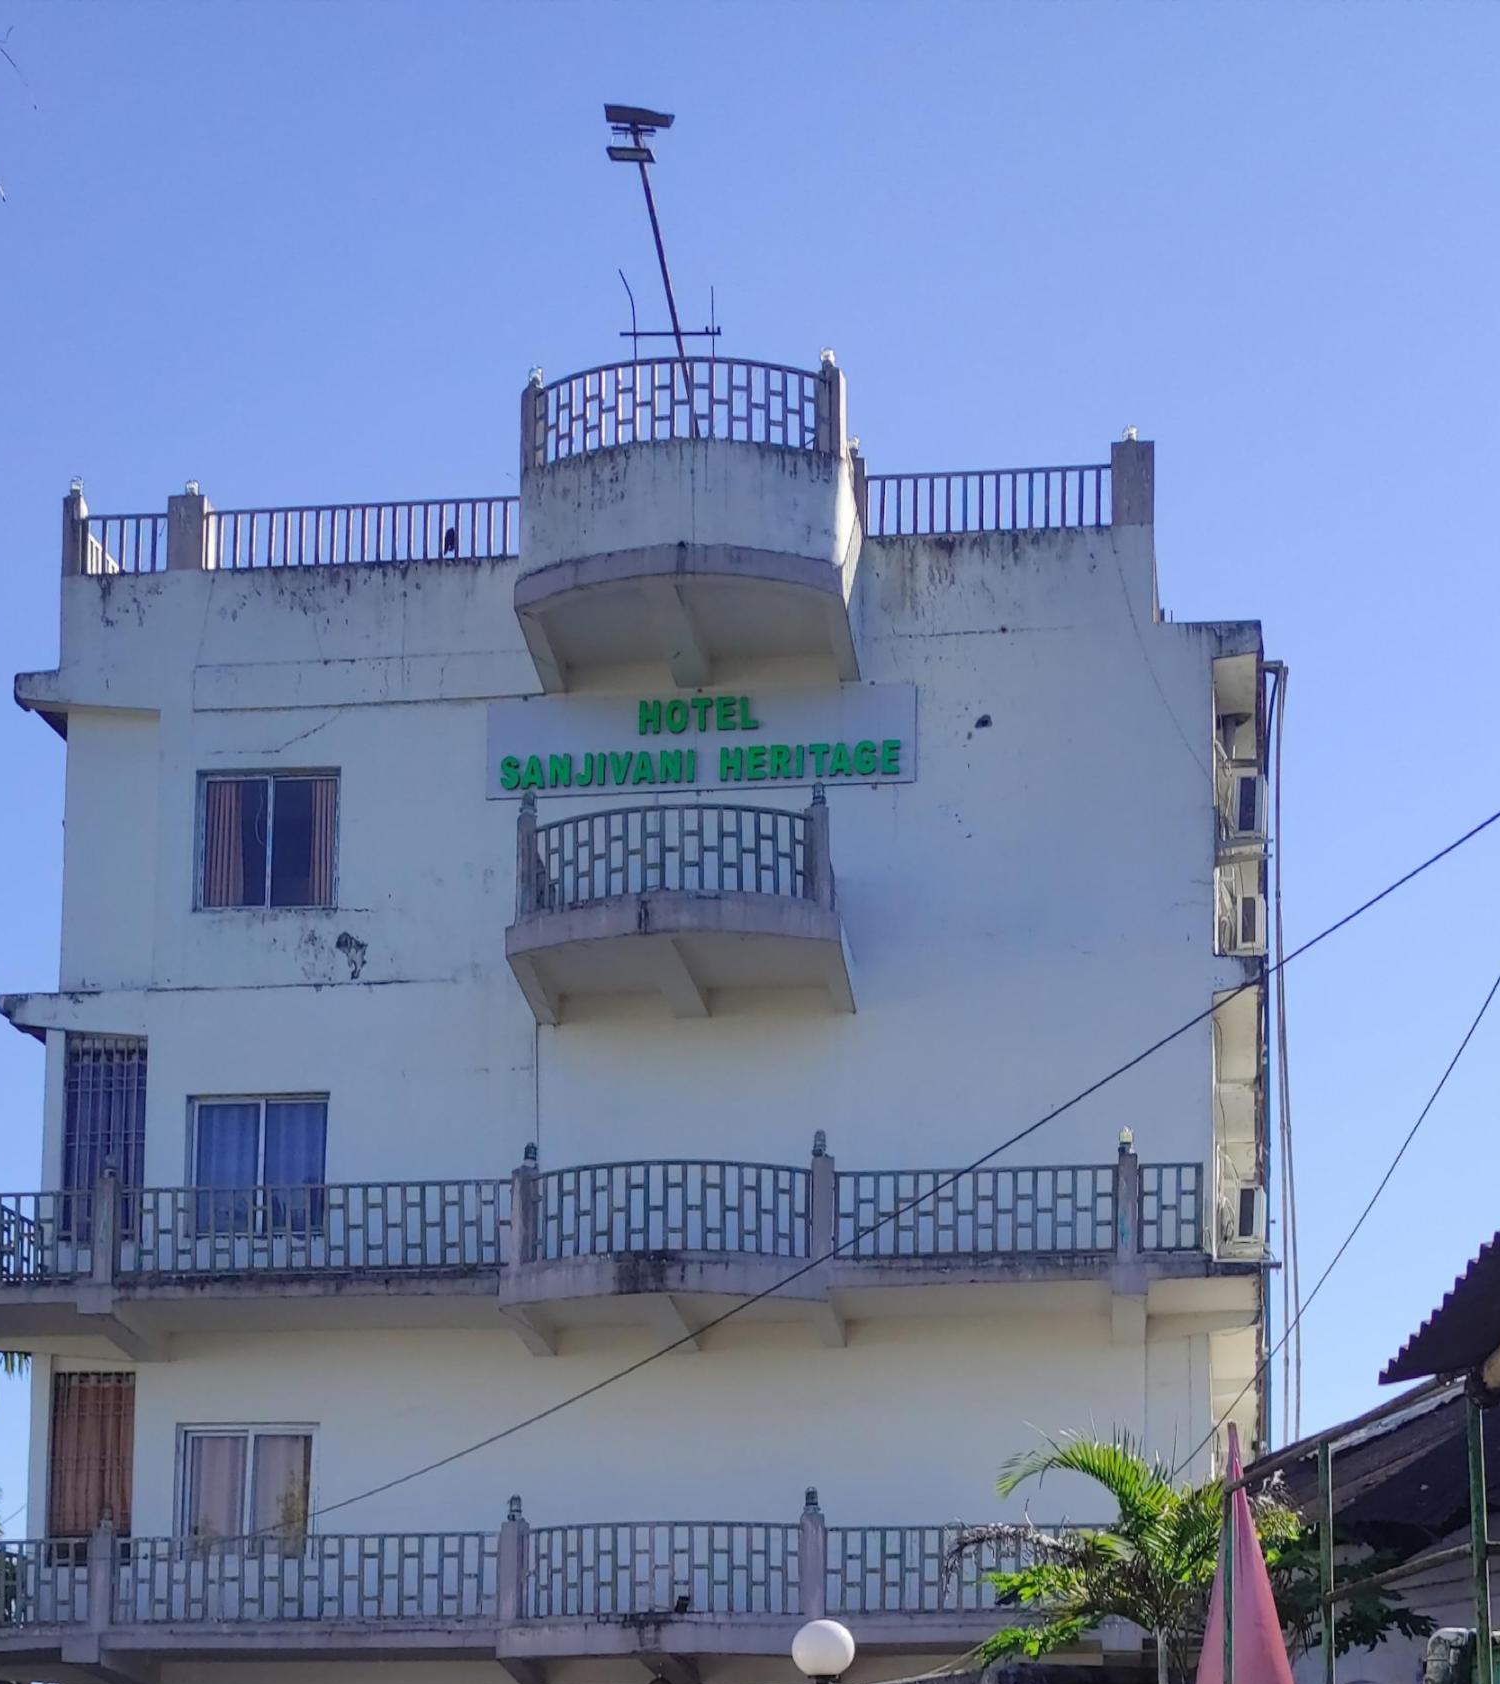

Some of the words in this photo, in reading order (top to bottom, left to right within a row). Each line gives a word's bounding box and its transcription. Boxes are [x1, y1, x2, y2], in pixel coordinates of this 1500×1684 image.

[638, 696, 759, 736] HOTEL
[499, 748, 696, 791] SANJIVANI
[719, 740, 902, 783] HERITAGE
